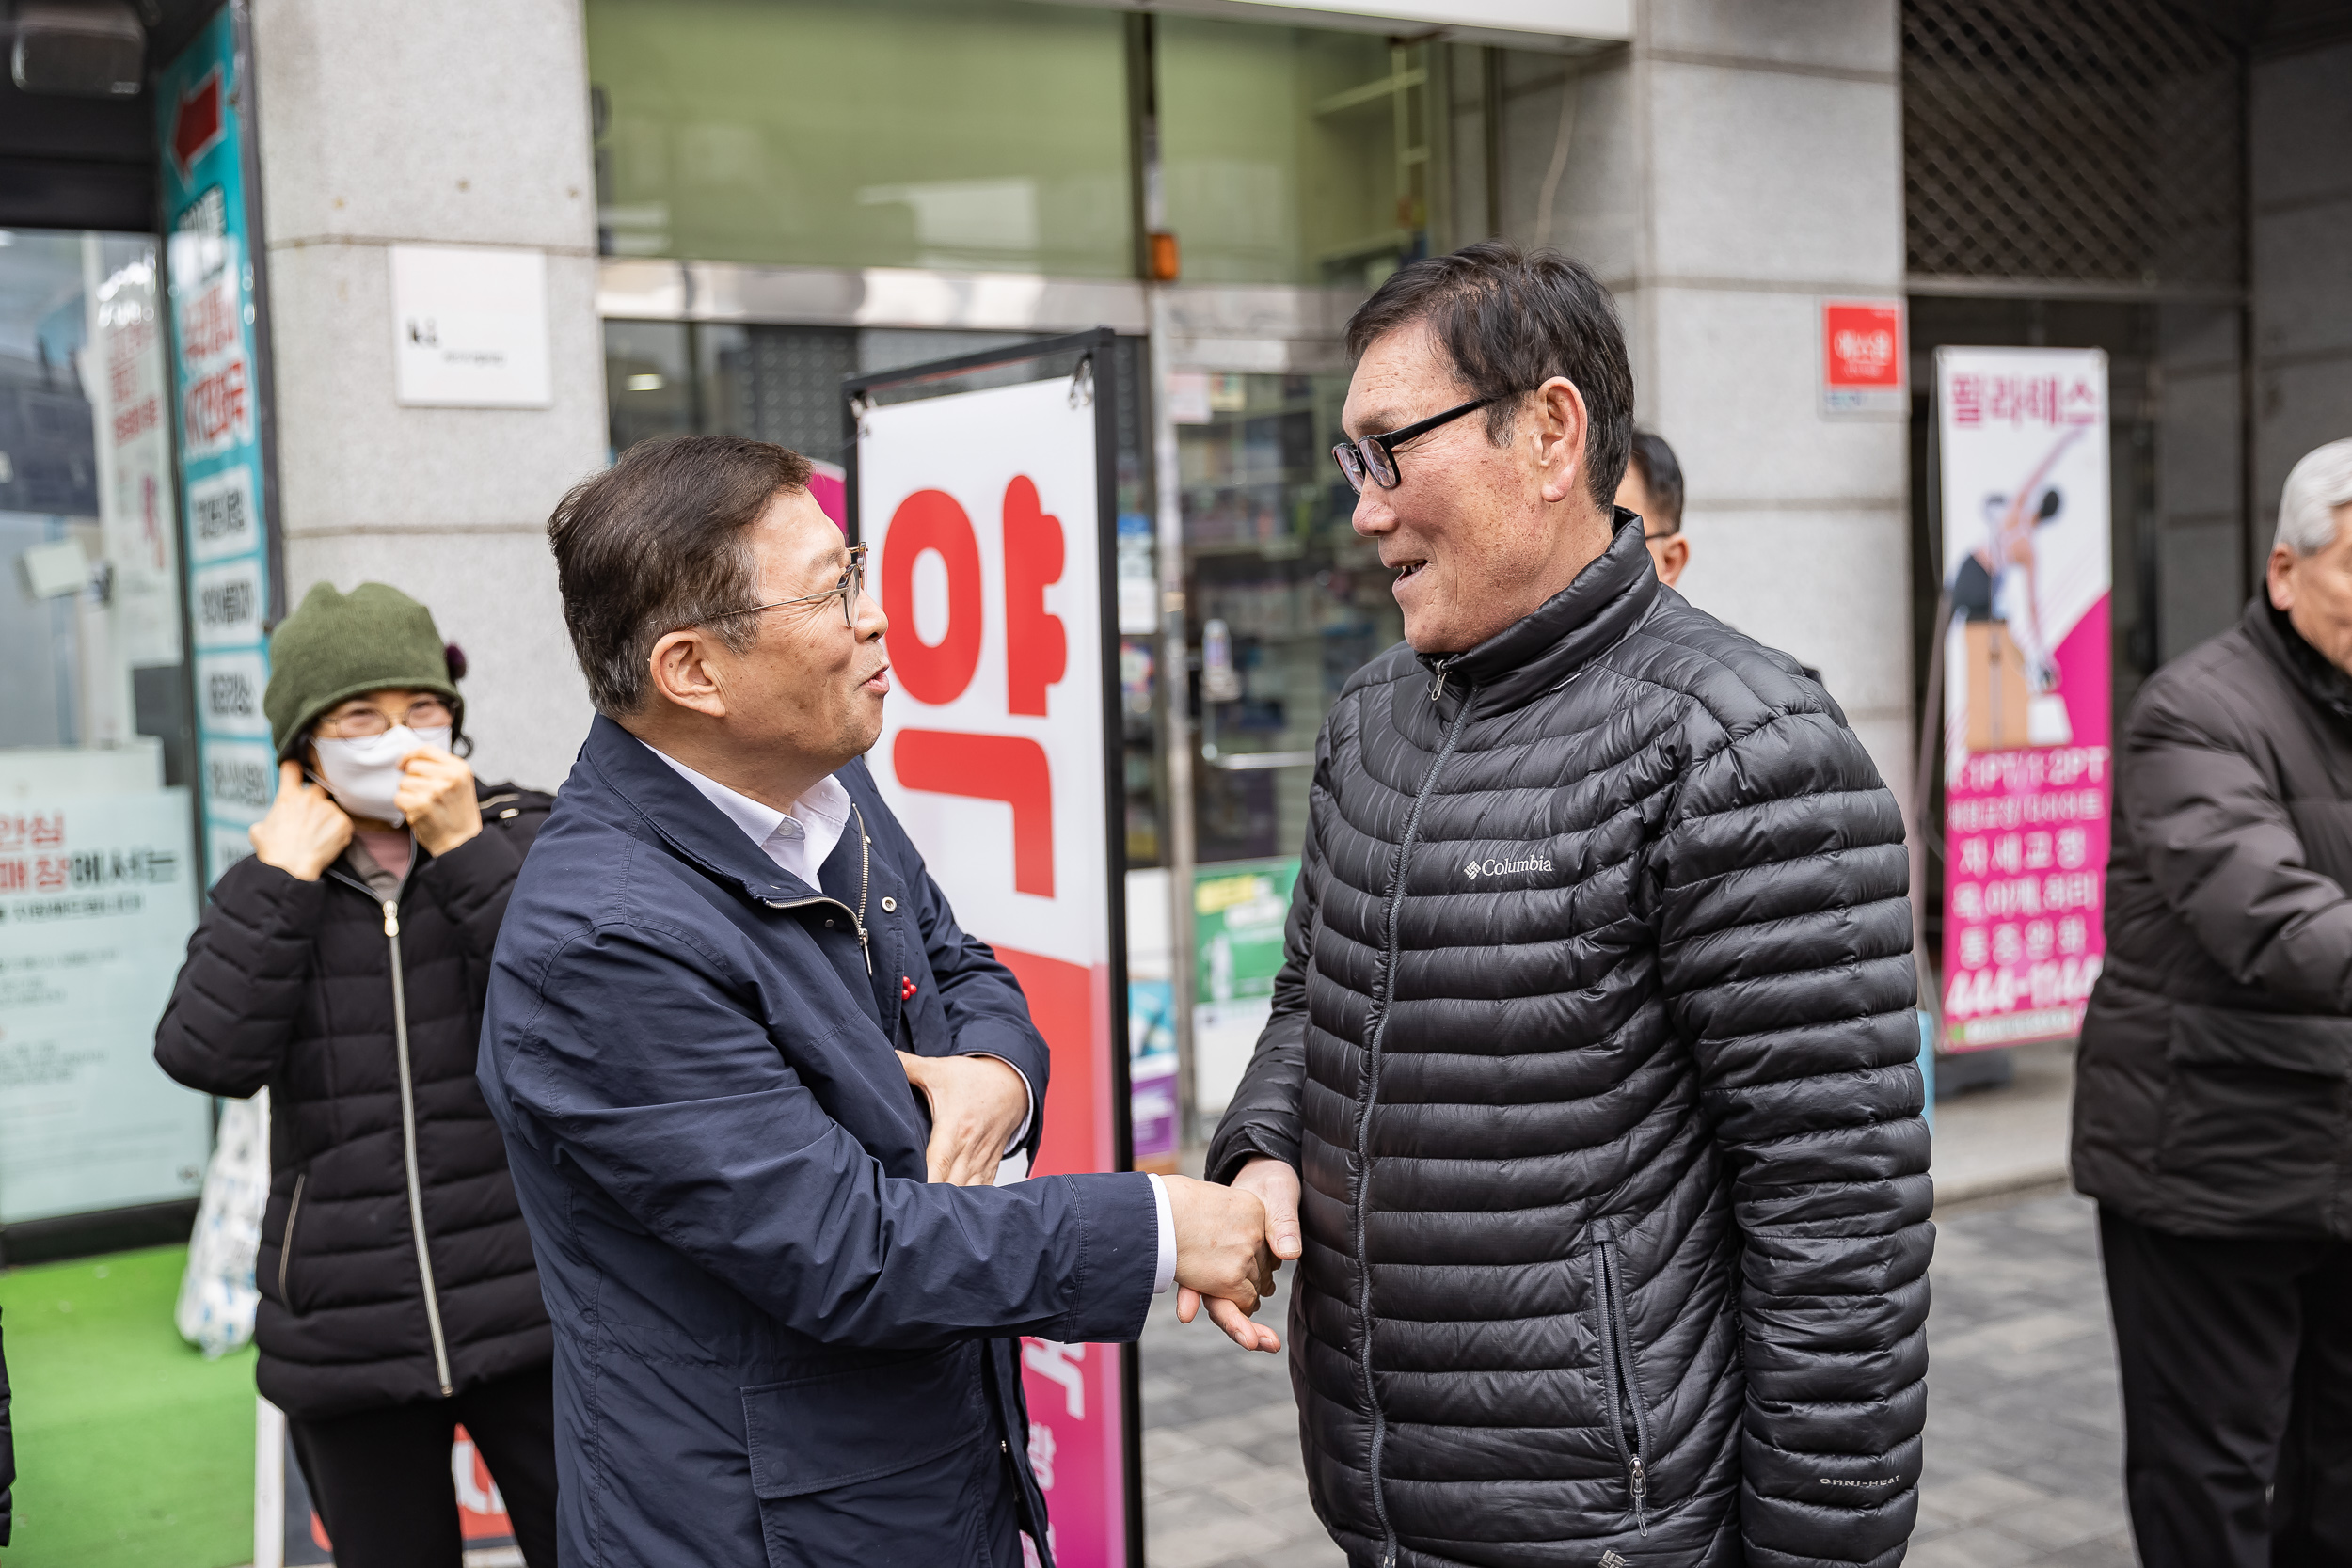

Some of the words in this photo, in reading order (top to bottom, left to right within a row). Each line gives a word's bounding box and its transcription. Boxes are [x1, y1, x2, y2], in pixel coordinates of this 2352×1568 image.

[1952, 373, 2102, 431] 필라테스
[882, 474, 1067, 898] 약
[1482, 854, 1553, 876] Columbia
[1820, 1474, 1900, 1487] OMNI-HEAT
